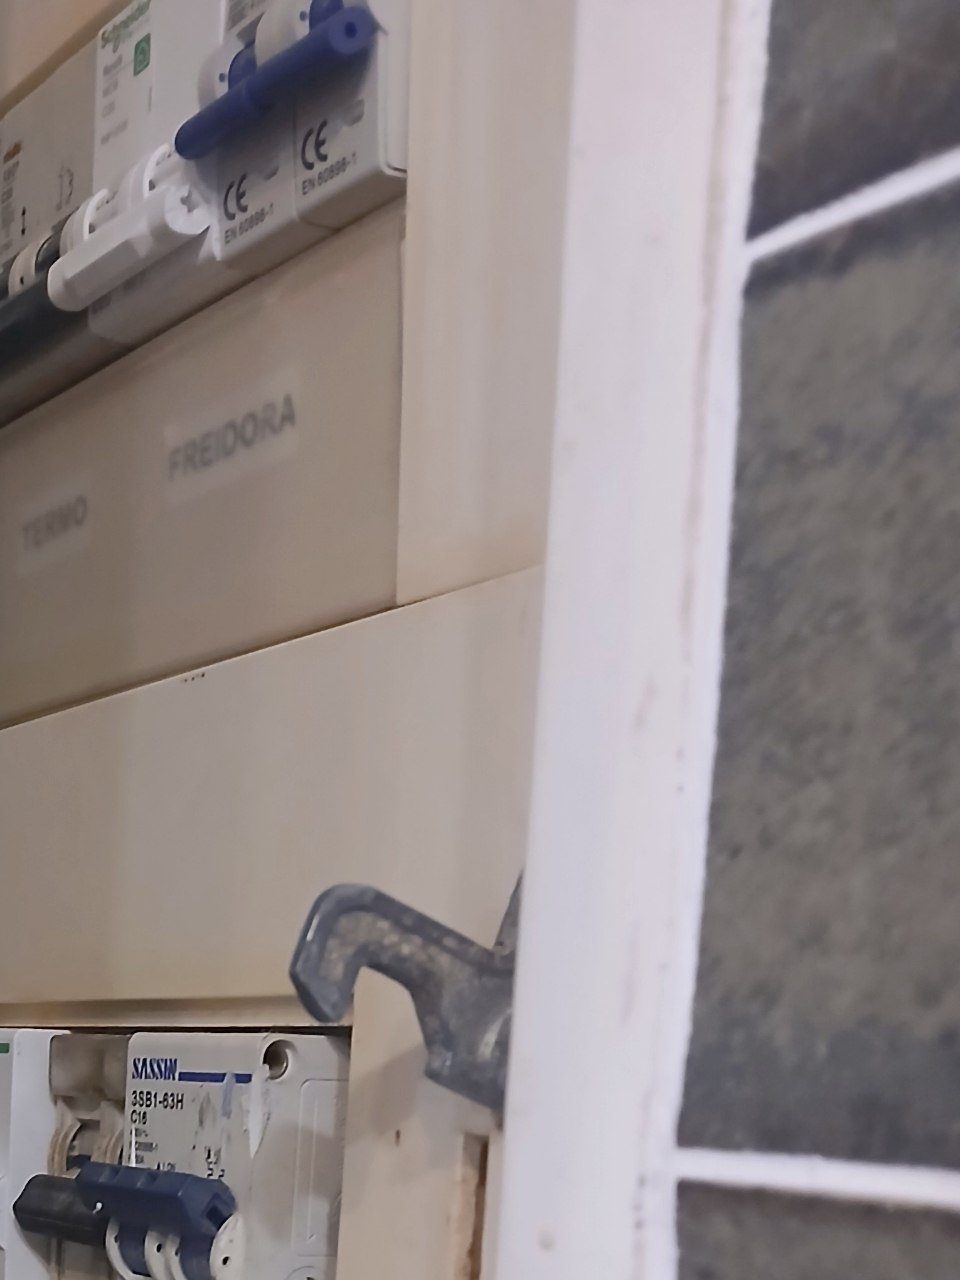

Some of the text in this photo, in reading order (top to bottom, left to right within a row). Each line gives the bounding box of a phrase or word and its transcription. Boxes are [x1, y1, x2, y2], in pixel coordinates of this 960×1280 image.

[301, 119, 328, 170] CE
[223, 172, 248, 221] CE
[302, 178, 315, 195] EN
[168, 393, 296, 482] FREIDORA
[131, 1090, 184, 1110] 3SB1-63H
